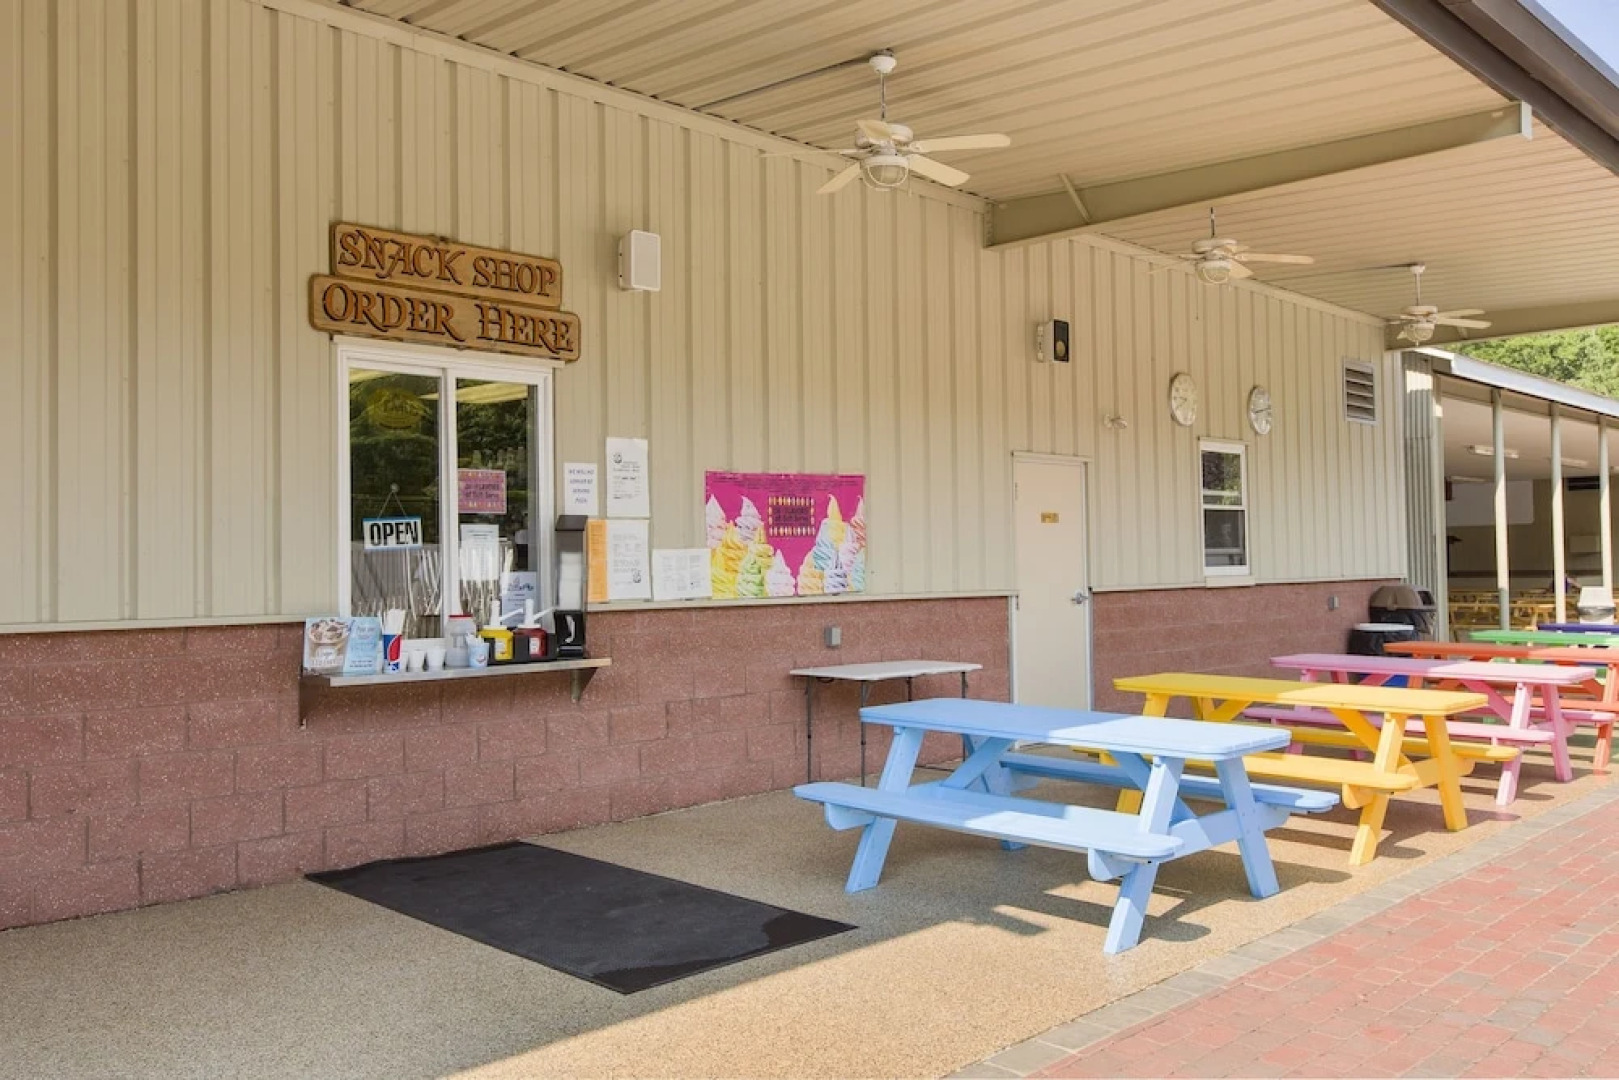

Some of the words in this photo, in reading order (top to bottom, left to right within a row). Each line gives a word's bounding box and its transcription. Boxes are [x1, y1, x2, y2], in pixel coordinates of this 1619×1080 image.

[338, 229, 466, 286] SNACK
[472, 254, 556, 297] SHOP
[322, 283, 466, 342] ORDER
[475, 303, 574, 354] HERE
[370, 520, 419, 546] OPEN
